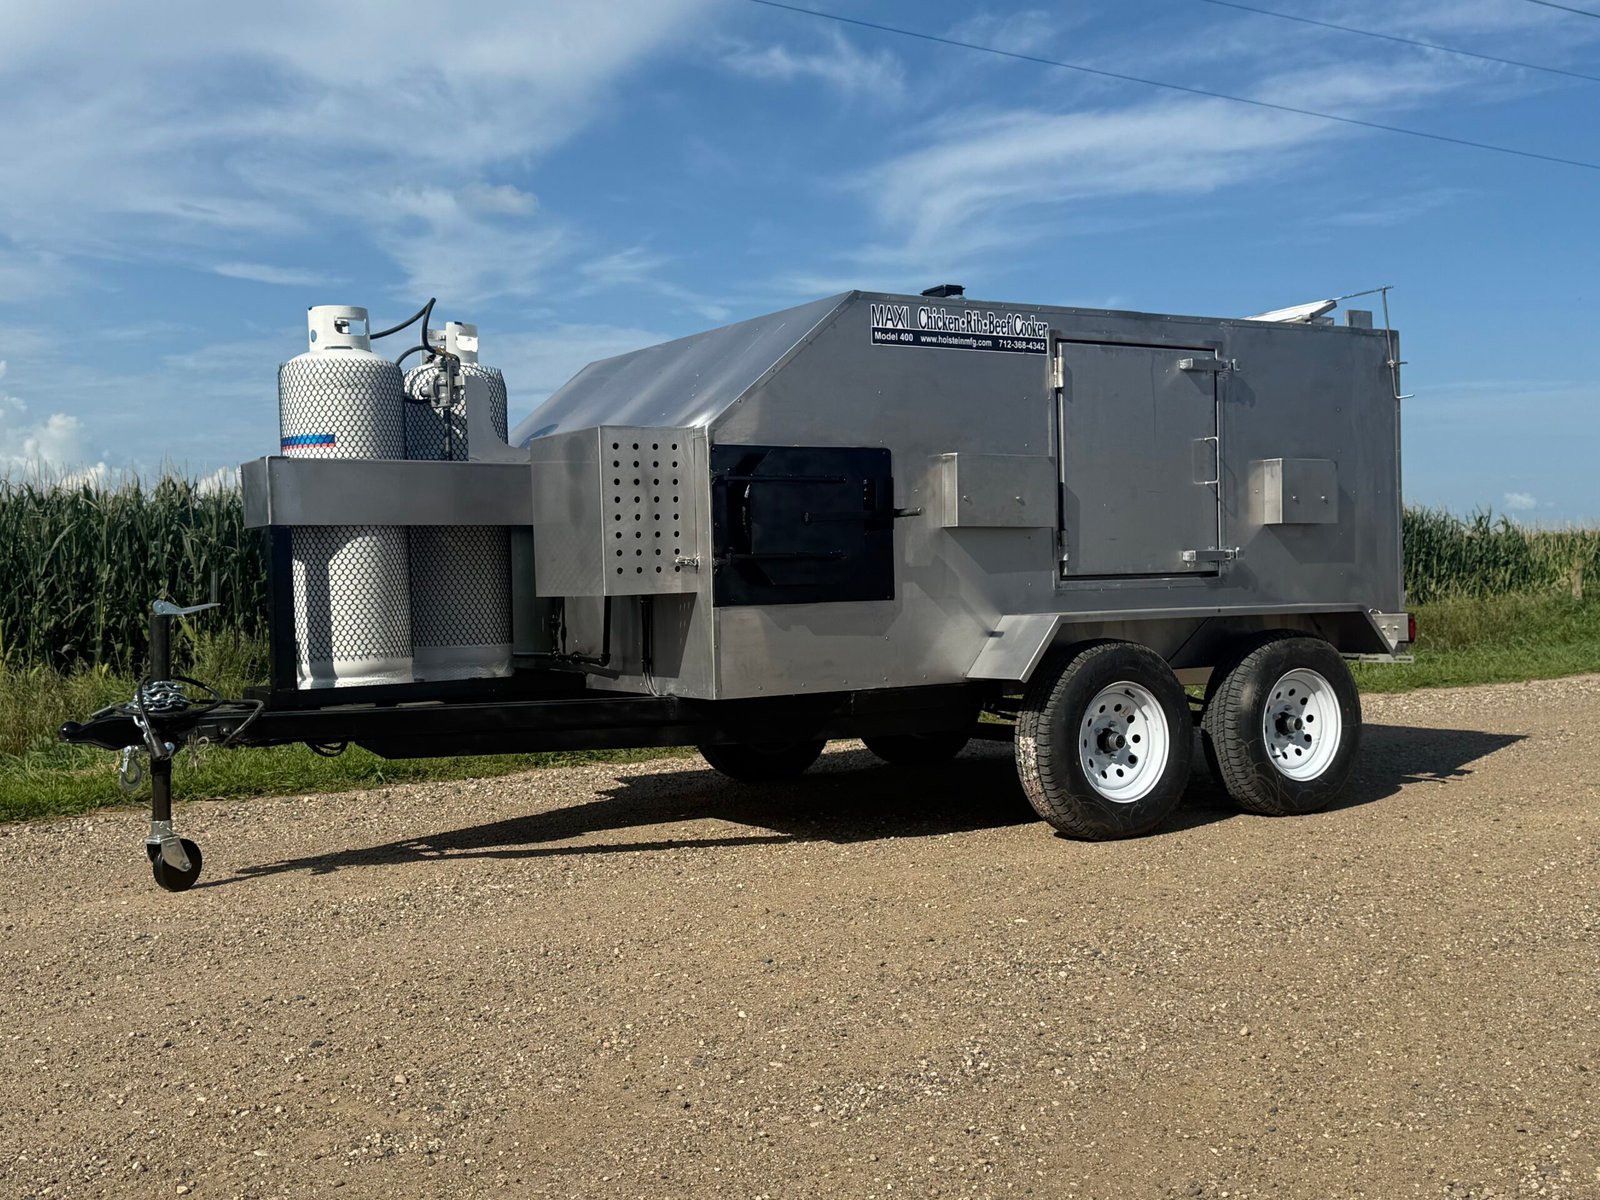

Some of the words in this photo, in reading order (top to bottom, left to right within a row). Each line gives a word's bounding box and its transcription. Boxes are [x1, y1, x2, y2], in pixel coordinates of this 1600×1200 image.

[871, 304, 910, 328] MAXI
[1012, 314, 1048, 338] Cooker
[874, 331, 898, 341] Model
[899, 332, 914, 342] 400
[920, 335, 992, 347] www.holsteinmfg.com
[998, 339, 1046, 351] 712-368-4342
